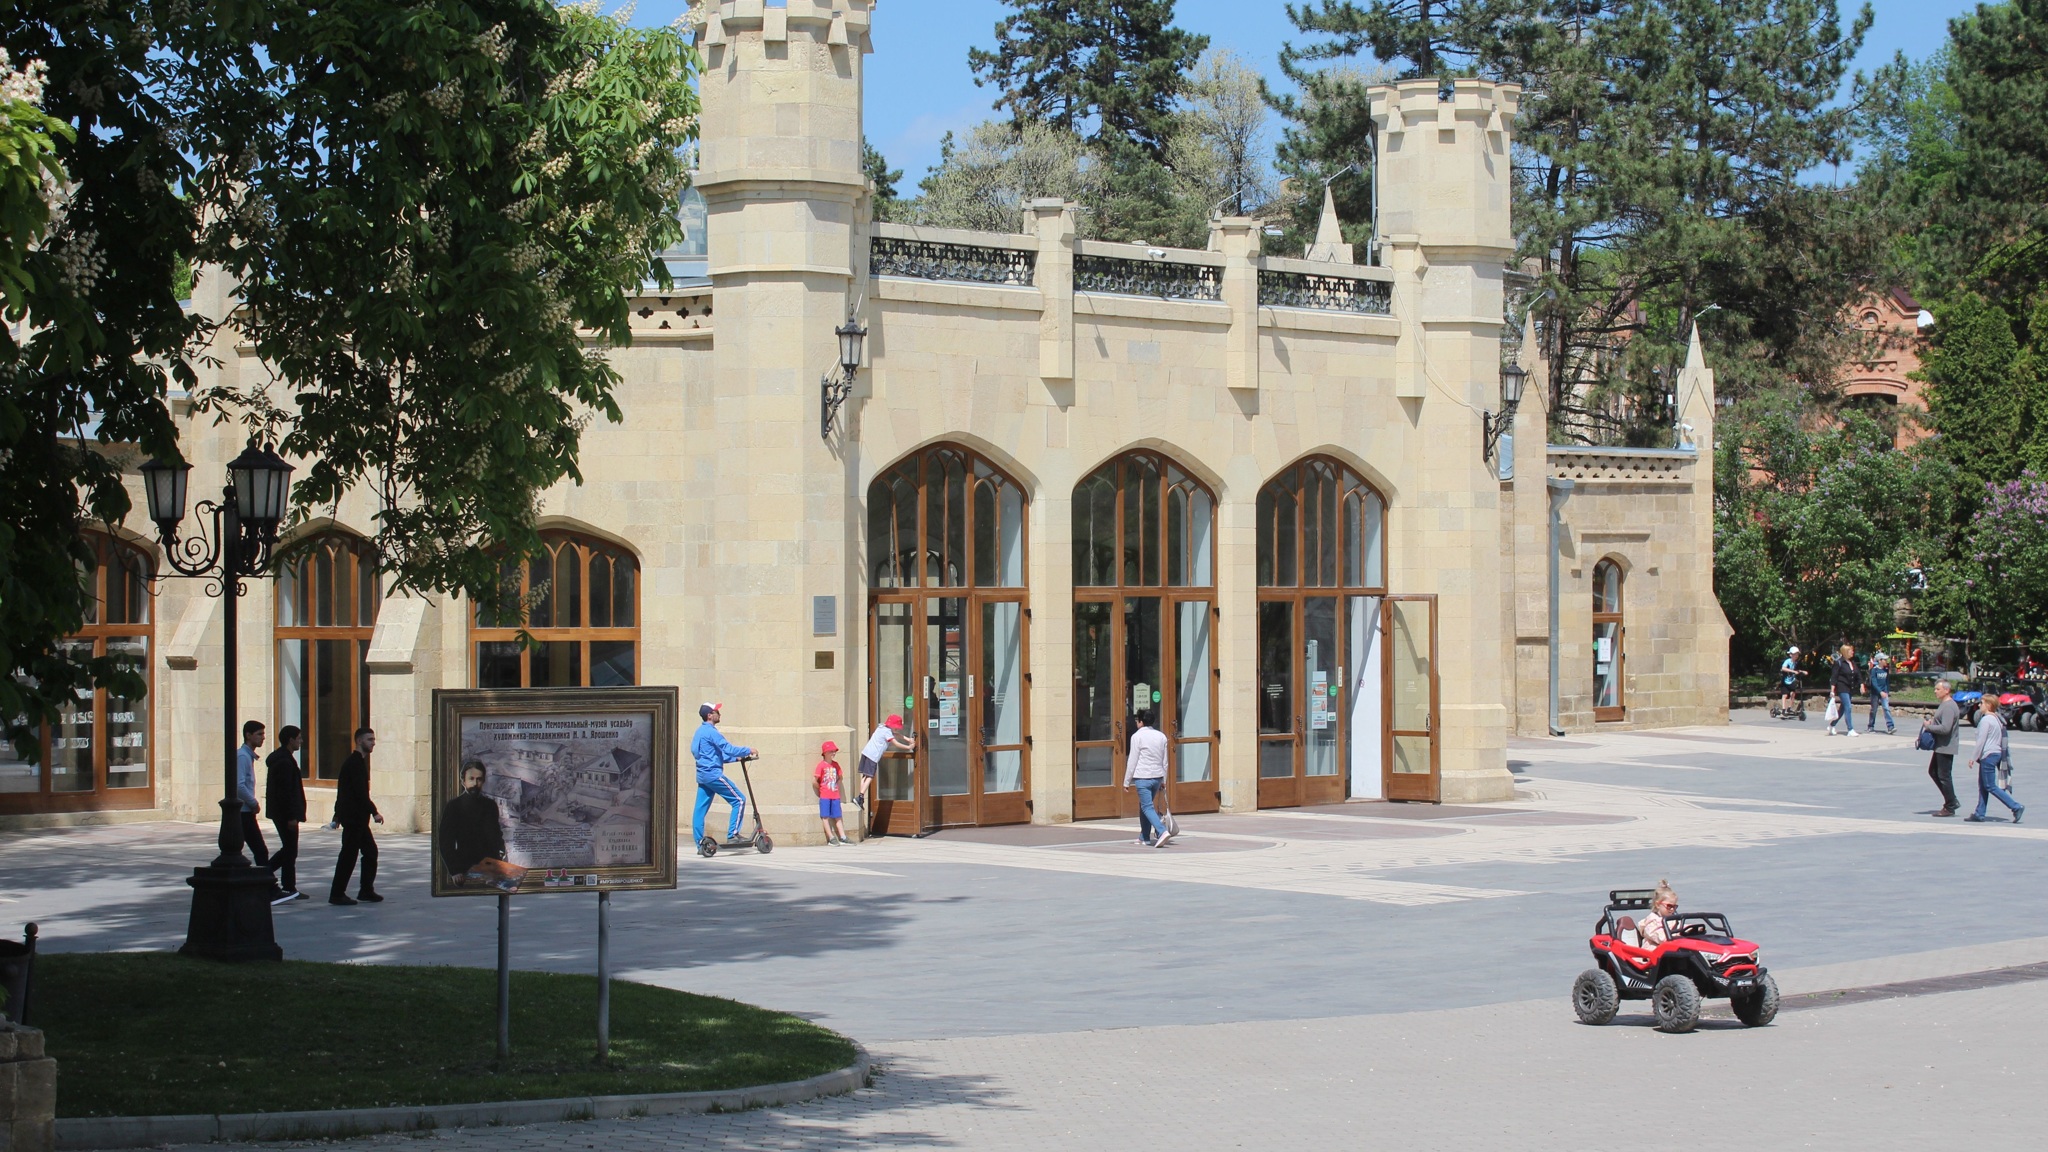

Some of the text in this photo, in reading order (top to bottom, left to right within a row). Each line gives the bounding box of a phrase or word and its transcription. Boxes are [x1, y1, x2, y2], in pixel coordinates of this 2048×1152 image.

[479, 721, 515, 730] Приглашаем
[517, 721, 542, 730] посетить
[610, 719, 633, 728] усадьбу
[590, 730, 619, 739] Ярошенко
